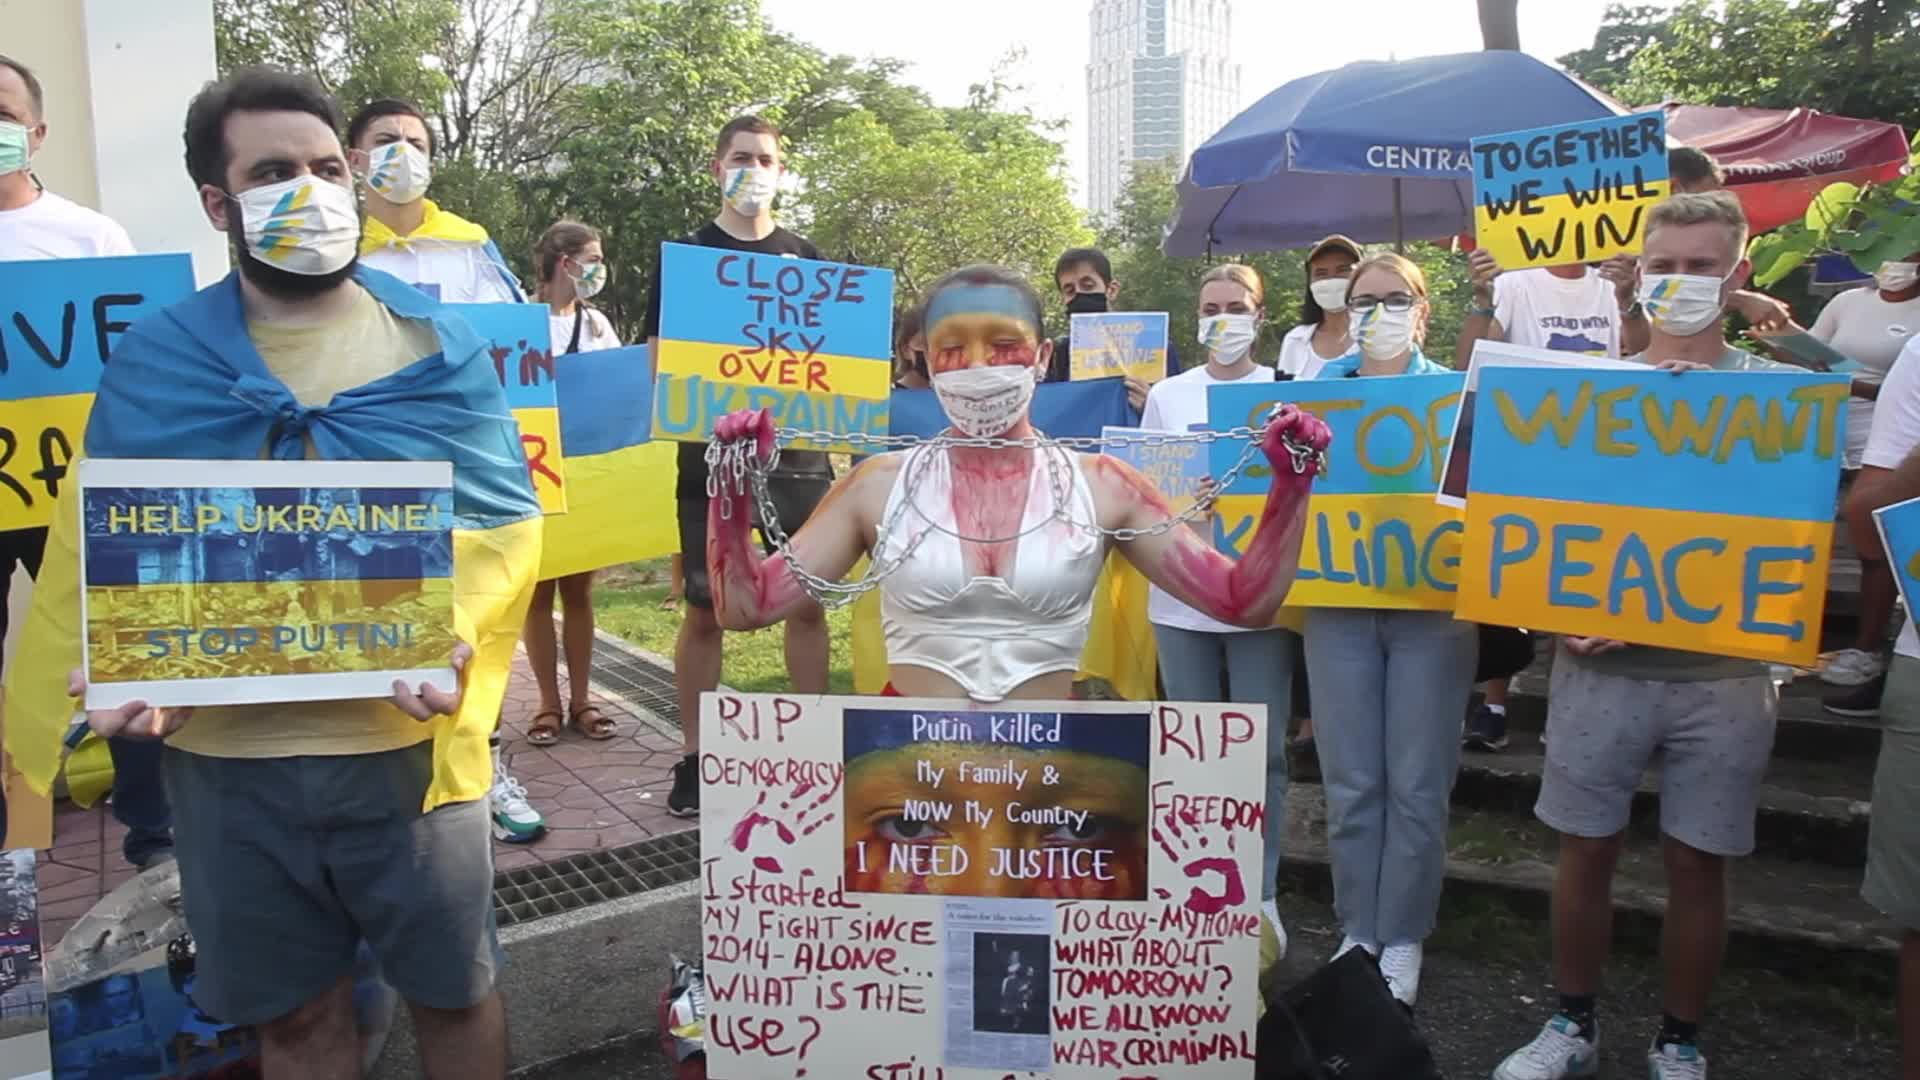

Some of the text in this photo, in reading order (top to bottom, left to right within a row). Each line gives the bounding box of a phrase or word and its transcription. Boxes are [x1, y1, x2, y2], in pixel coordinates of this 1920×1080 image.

[1473, 117, 1665, 179] TOGETHER
[1484, 165, 1660, 221] WE WILL
[1516, 206, 1644, 262] WIN
[716, 255, 869, 303] CLOSE
[738, 324, 826, 362] SKY
[719, 352, 831, 392] OVER
[1641, 384, 1850, 465] WANT
[109, 503, 442, 535] HELP UKRAINE!
[1489, 513, 1816, 642] PEACE
[148, 622, 415, 658] STOP PUTIN!
[718, 696, 802, 742] RIP
[912, 713, 1062, 743] Putin Killed
[1159, 706, 1254, 762] RIP
[917, 760, 1060, 790] My Family &
[903, 799, 1088, 831] NOW My Country
[704, 857, 722, 900] I
[856, 841, 1116, 881] I NEED JUSTICE
[1055, 936, 1224, 968] WHAT ABOUT
[706, 973, 808, 1007] WHAT
[853, 982, 926, 1014] THE
[1053, 1003, 1232, 1032] WE ALL KNOW
[1055, 1038, 1123, 1068] WAR
